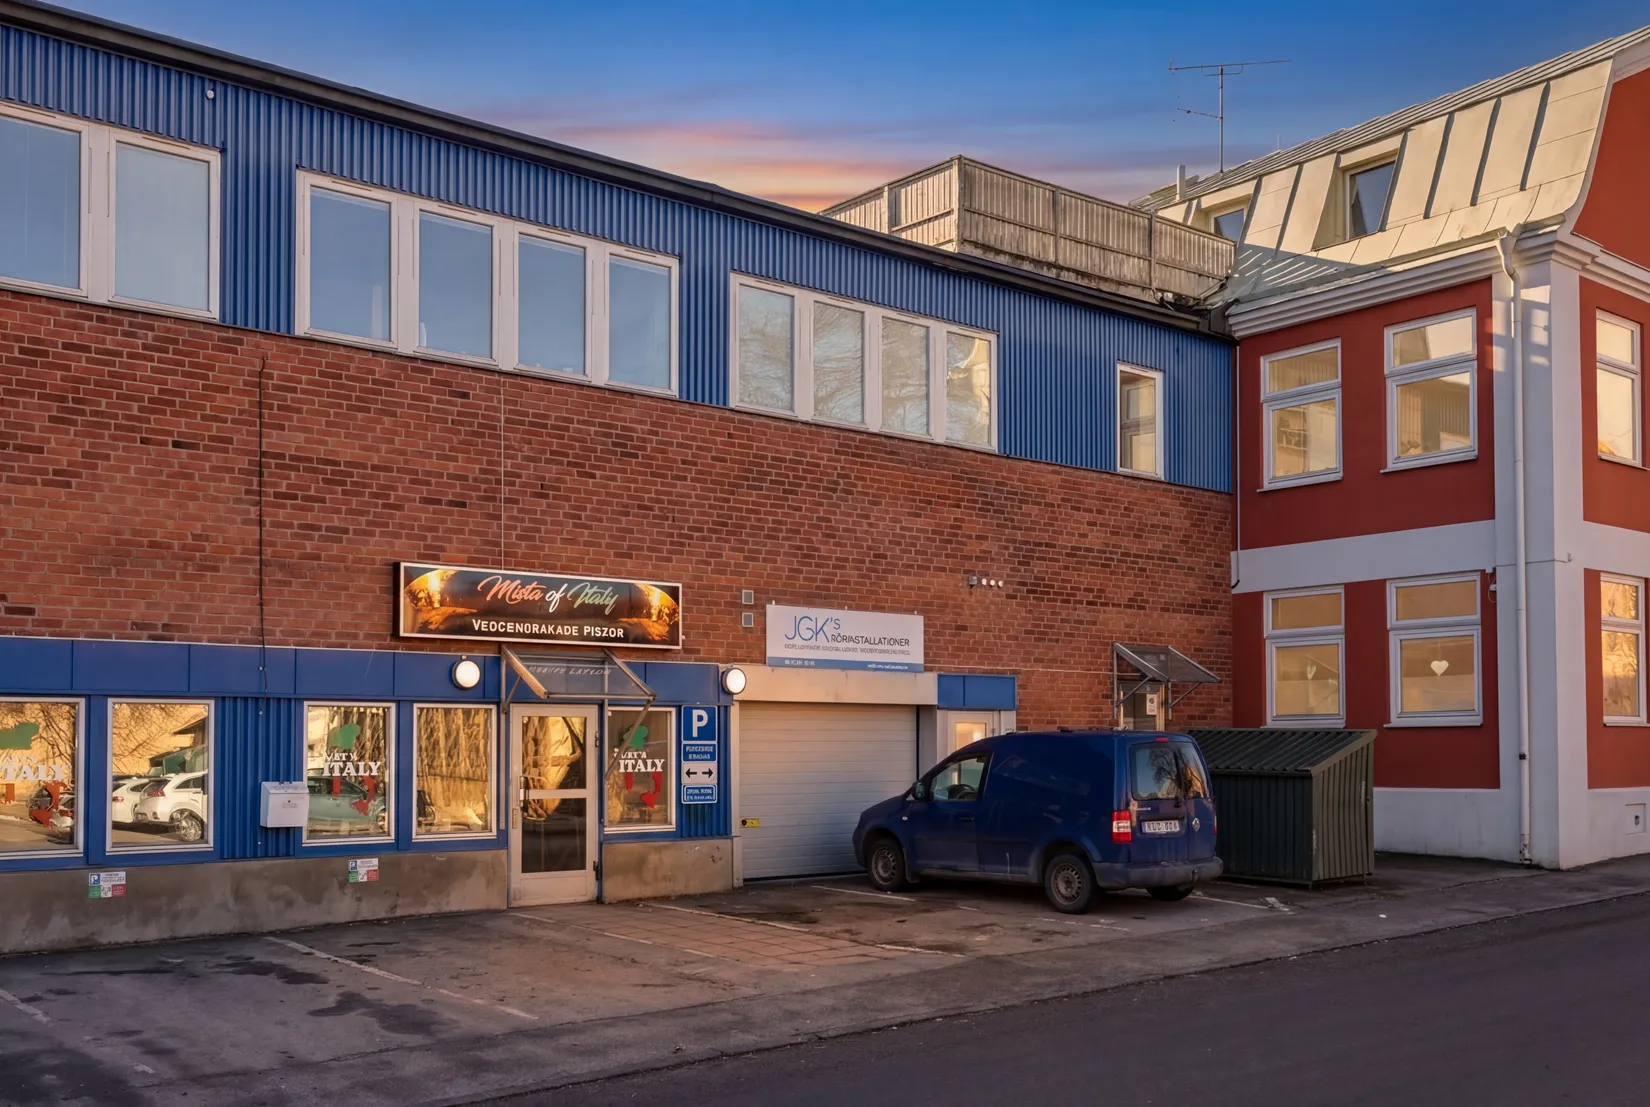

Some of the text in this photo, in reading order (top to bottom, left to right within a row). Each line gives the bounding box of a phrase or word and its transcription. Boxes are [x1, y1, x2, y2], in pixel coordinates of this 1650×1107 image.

[545, 583, 566, 613] of
[583, 624, 624, 638] PISZOR
[692, 709, 708, 738] P
[0, 763, 69, 781] TALY
[322, 761, 382, 777] ITALY
[619, 759, 665, 773] ITALY
